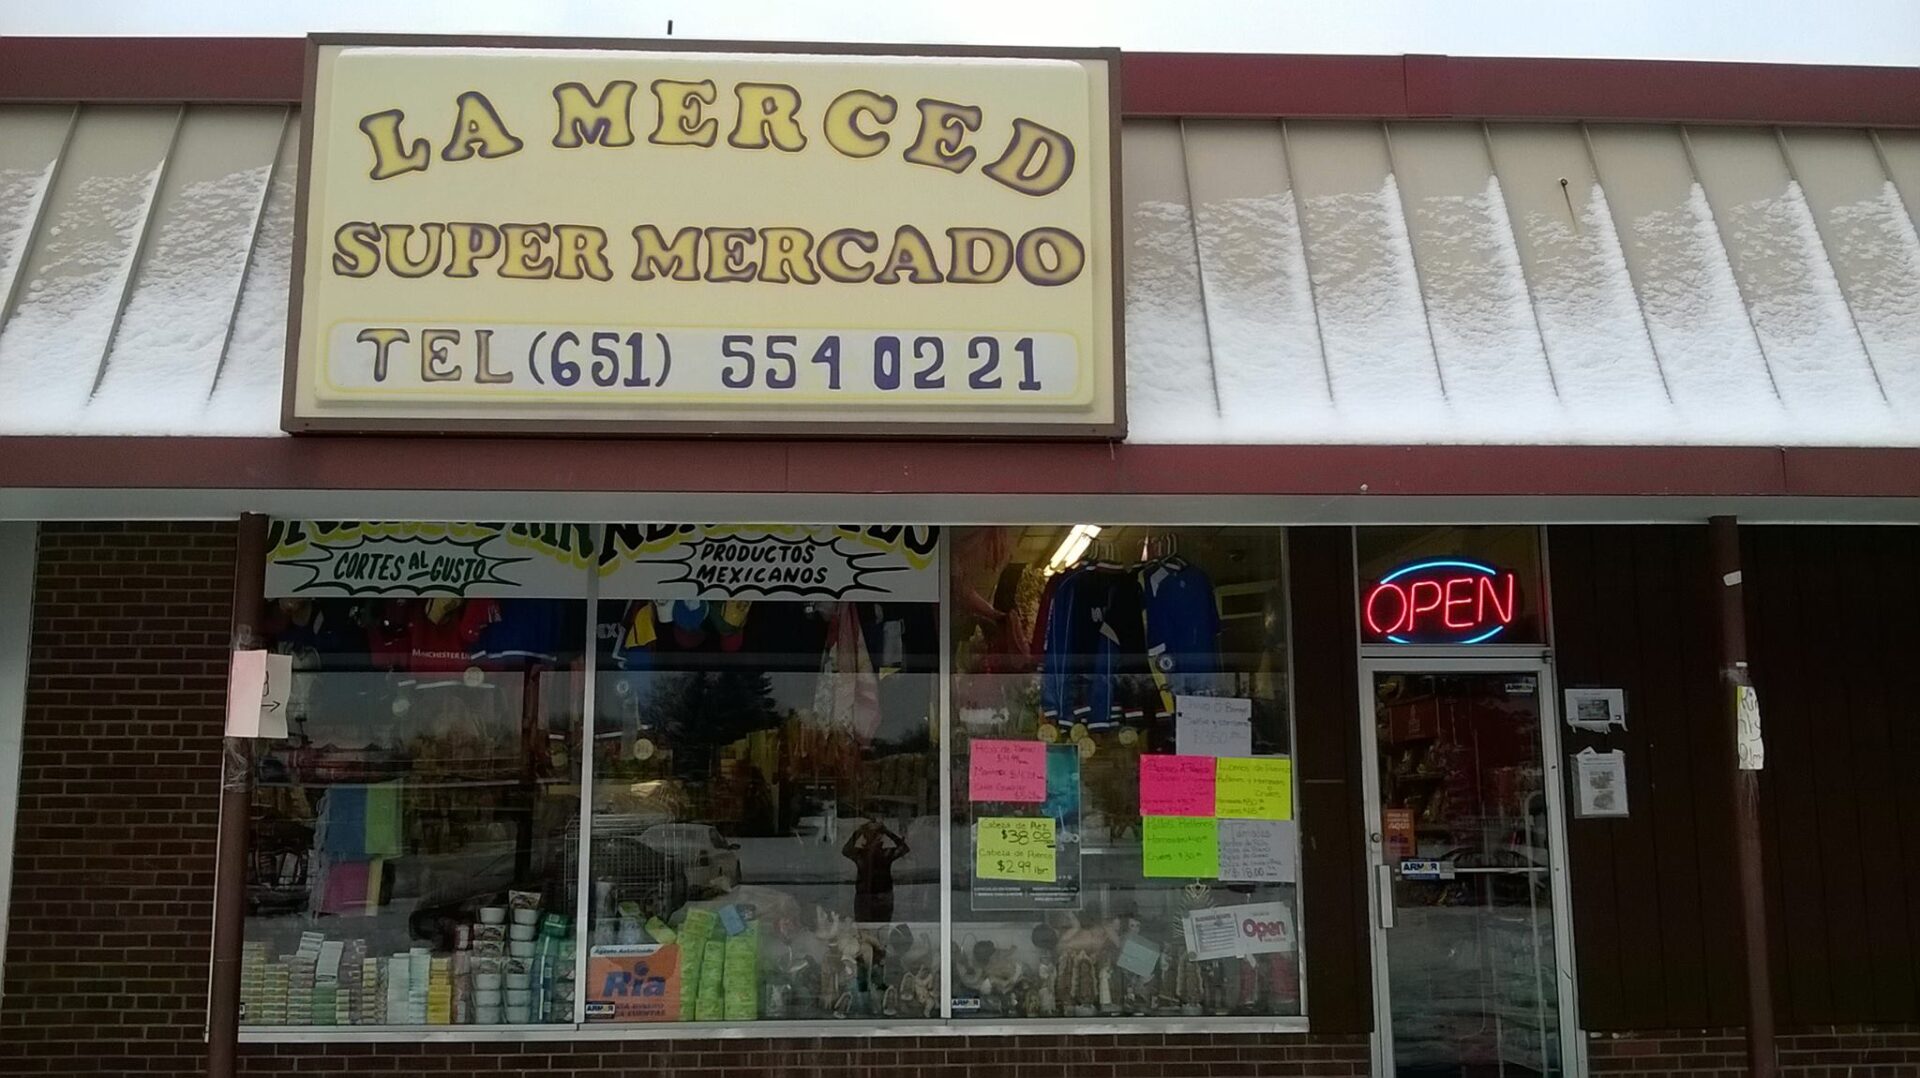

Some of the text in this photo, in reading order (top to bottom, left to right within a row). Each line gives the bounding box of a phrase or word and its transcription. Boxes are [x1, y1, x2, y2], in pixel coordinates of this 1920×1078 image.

[358, 78, 1077, 198] LA MERCED
[331, 221, 1087, 288] SUPER MERCADO
[721, 334, 843, 391] 554
[873, 335, 1043, 393] 0221
[333, 550, 487, 583] CORTES AL GUSTO
[699, 542, 817, 564] PRODUCTOS
[695, 565, 829, 585] MEXICANOS
[1366, 572, 1515, 635] OPEN
[1403, 862, 1438, 872] ARMR
[1241, 918, 1287, 943] Open
[602, 959, 667, 998] Ria
[587, 1004, 614, 1012] ARMR
